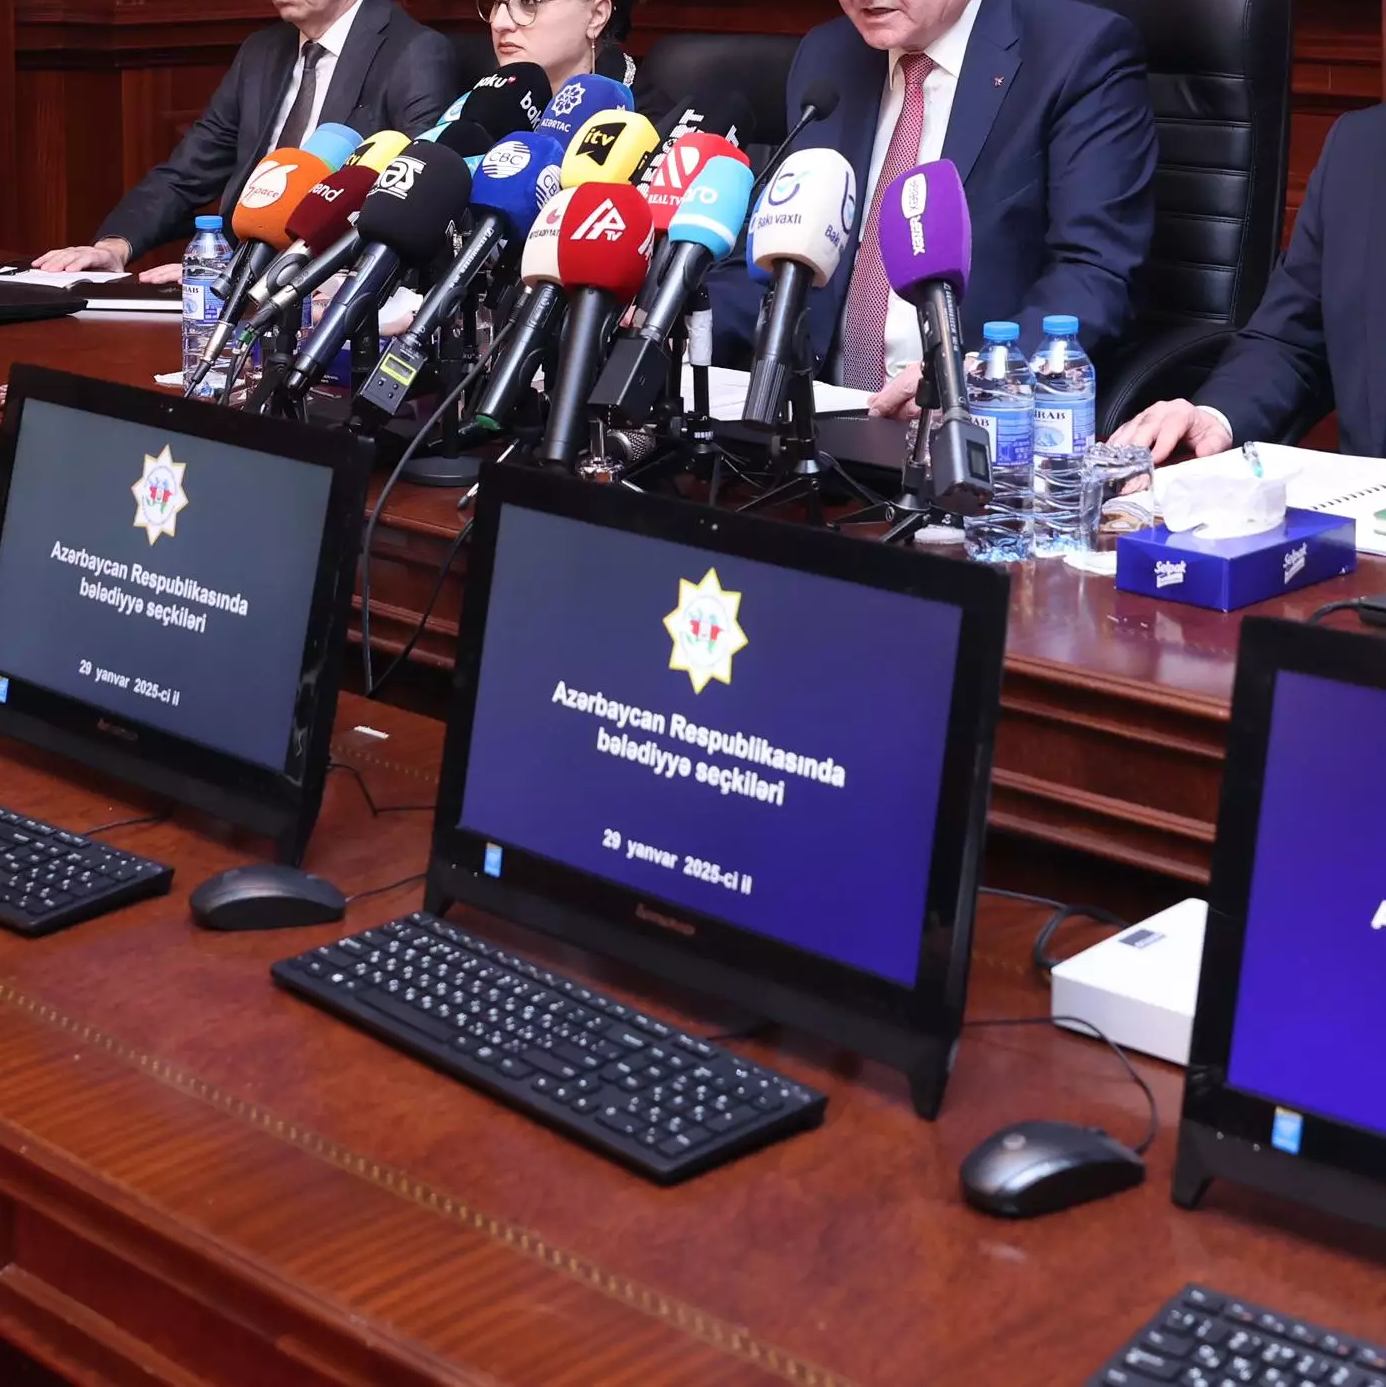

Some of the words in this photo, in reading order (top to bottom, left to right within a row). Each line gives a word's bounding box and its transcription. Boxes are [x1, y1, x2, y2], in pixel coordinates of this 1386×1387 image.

[520, 90, 542, 133] bak
[584, 128, 615, 146] itv
[489, 151, 524, 166] CBC
[51, 541, 128, 580] Azərbaycan
[130, 563, 249, 615] Respublikasında
[79, 577, 144, 615] bələdiyyə
[146, 599, 207, 633] seçkiləri
[79, 659, 92, 675] 29
[95, 665, 130, 688] yanvar
[133, 677, 171, 702] 2025-ci
[172, 690, 180, 706] il
[552, 681, 665, 734] Azərbaycan
[670, 714, 846, 788] Respublikasında
[596, 728, 691, 777] bələdiyyə
[695, 758, 784, 806] seçkiləri
[602, 829, 621, 849] 29
[627, 839, 677, 870] yanvar
[683, 856, 739, 891] 2025-ci
[741, 875, 752, 895] il
